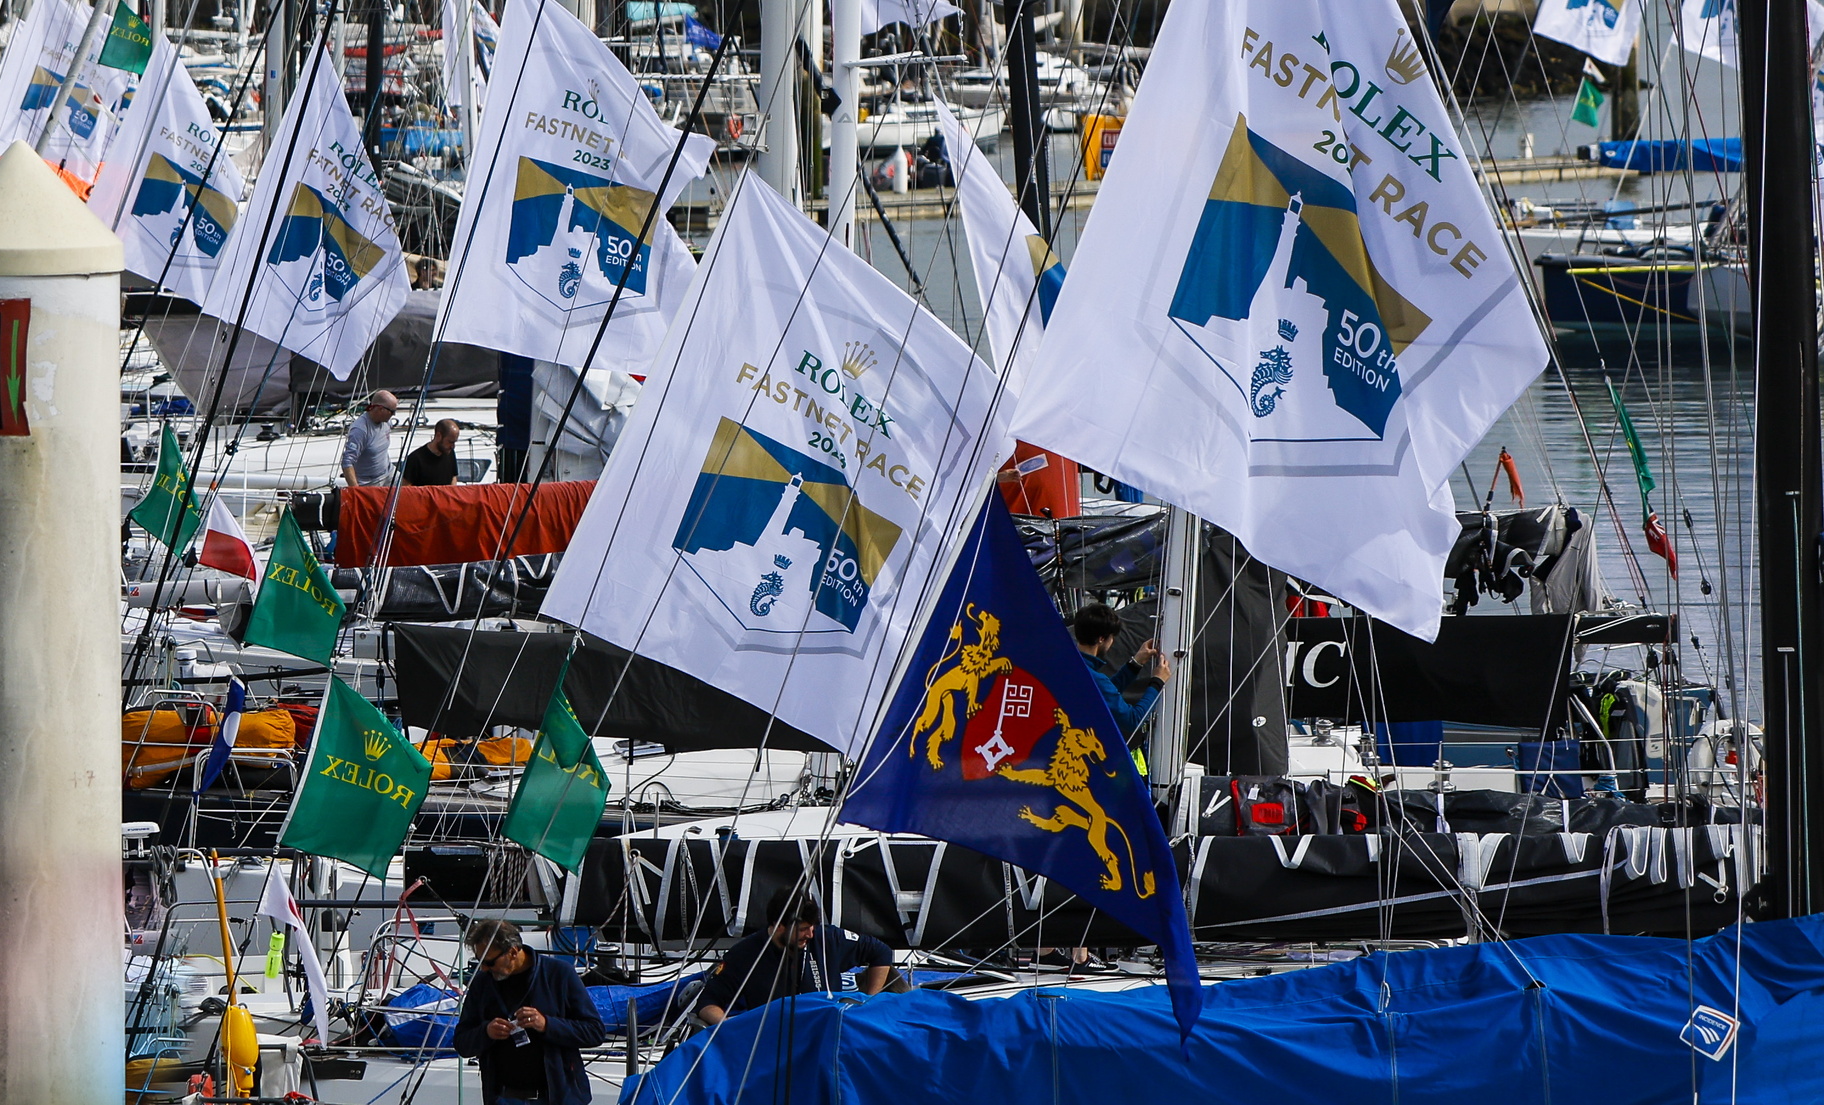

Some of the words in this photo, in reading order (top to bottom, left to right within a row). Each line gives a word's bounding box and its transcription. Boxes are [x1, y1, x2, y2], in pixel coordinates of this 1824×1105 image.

[159, 126, 212, 164] FASTNE
[187, 122, 219, 149] ROL
[525, 111, 614, 154] FASTNET
[1313, 130, 1351, 166] 20
[328, 141, 380, 190] ROLE
[573, 149, 611, 170] 2023
[1369, 174, 1488, 280] RACE
[1337, 309, 1399, 376] 50th
[1333, 347, 1390, 393] EDITION
[795, 350, 895, 439] ROLEX
[736, 362, 853, 445] FASTNET
[855, 438, 926, 500] RACE
[821, 574, 858, 607] EDITION
[825, 548, 864, 597] 50th
